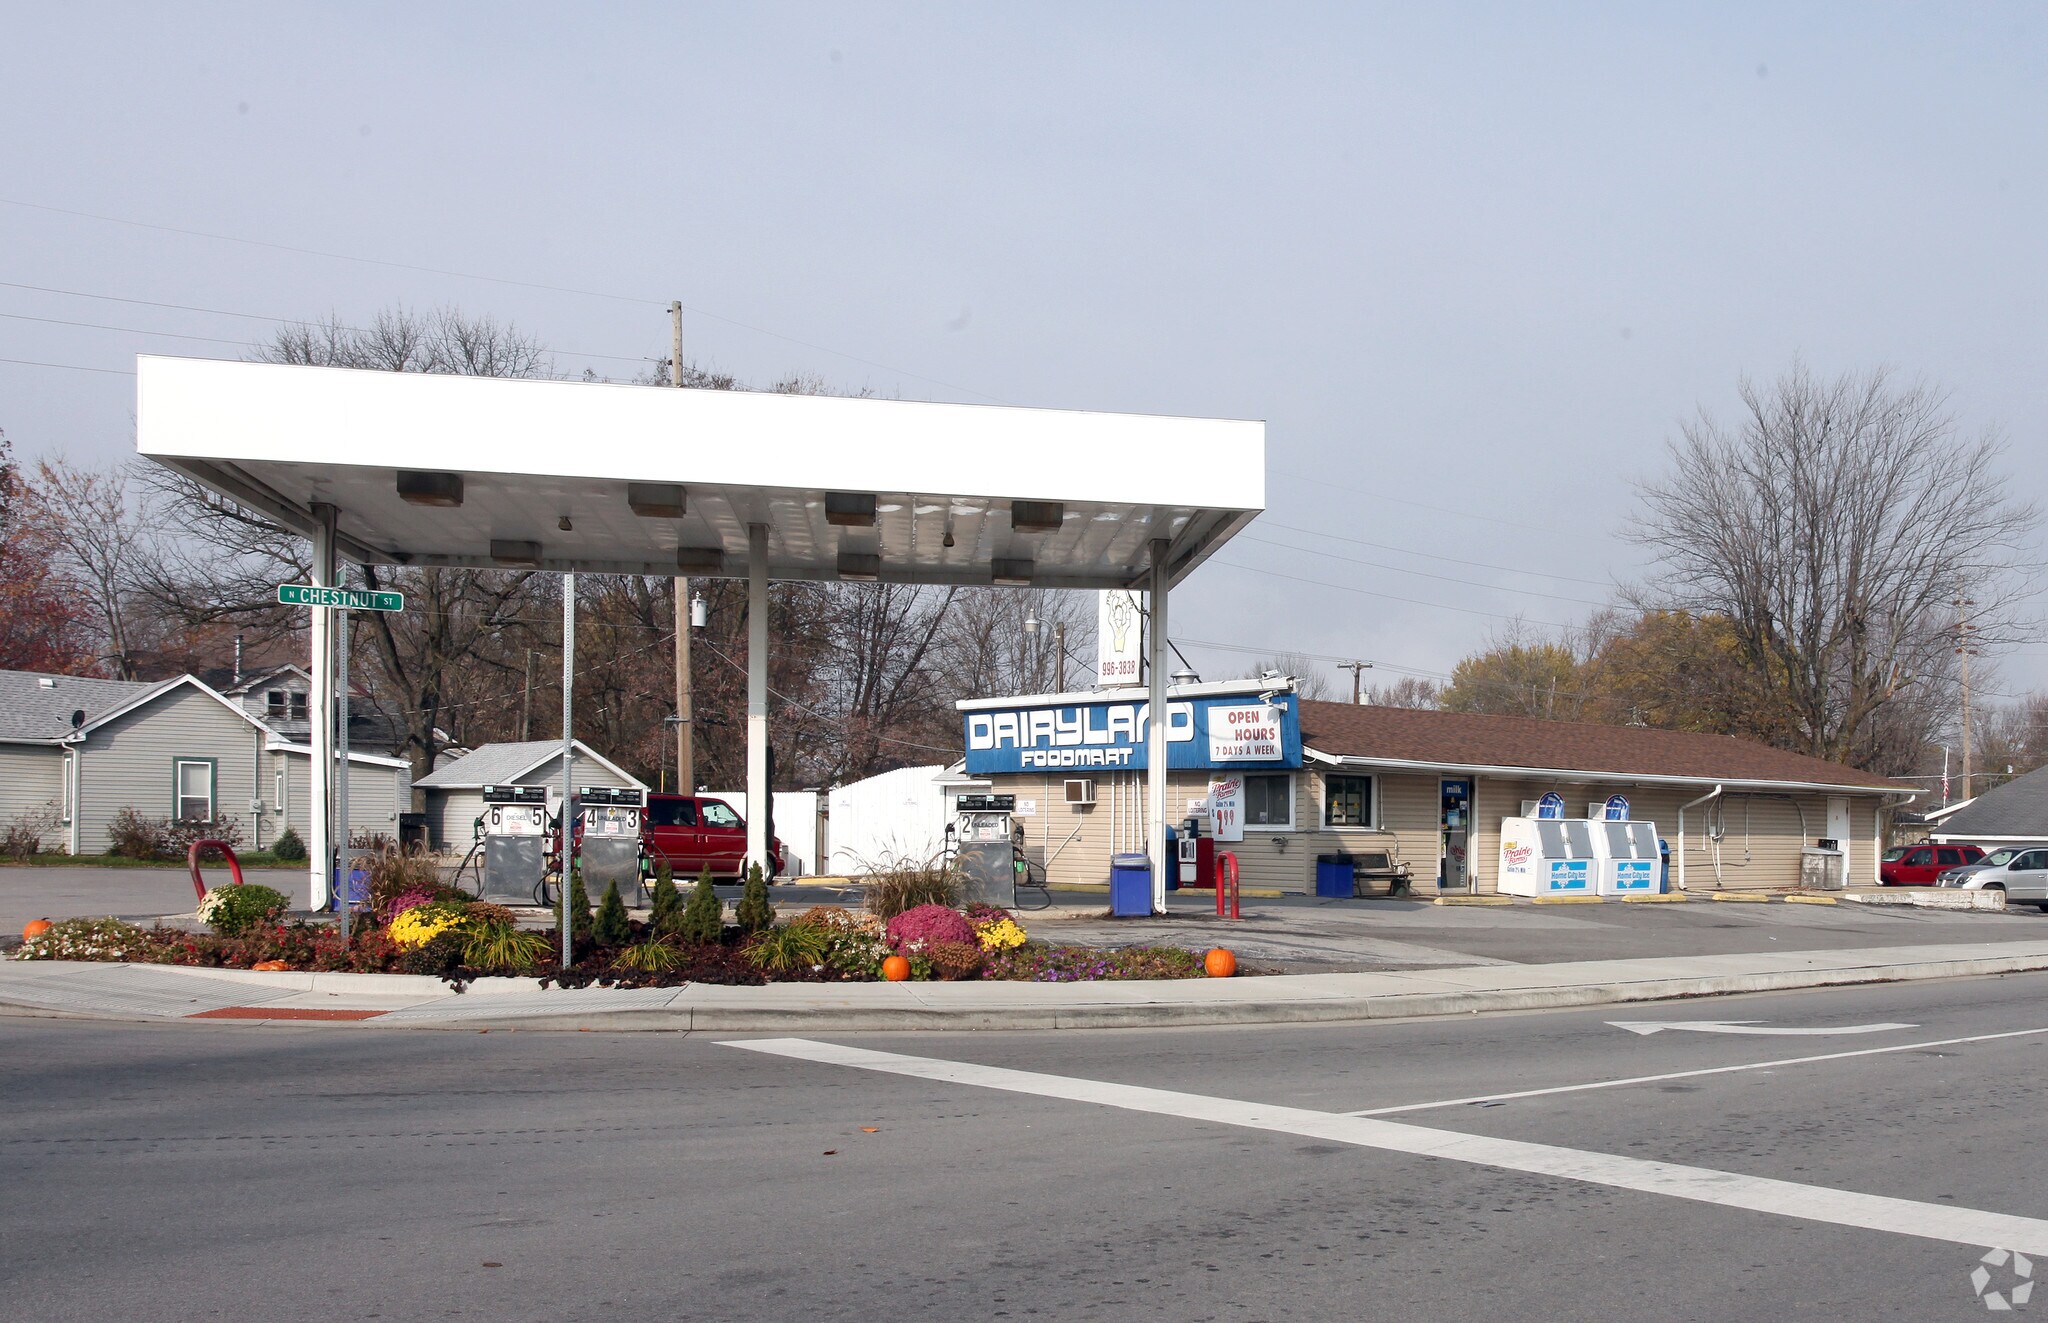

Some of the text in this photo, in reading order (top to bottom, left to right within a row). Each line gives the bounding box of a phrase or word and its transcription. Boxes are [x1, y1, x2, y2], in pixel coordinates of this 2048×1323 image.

[300, 588, 378, 607] CHESTNUT
[384, 597, 393, 606] ST
[1103, 660, 1136, 676] 996-3838
[1228, 710, 1260, 724] OPEN
[969, 701, 1195, 750] DAIRYLAND
[1235, 727, 1275, 741] HOURS
[1021, 747, 1133, 768] FOODMART
[1215, 745, 1275, 756] 7 DAYS A WEEK
[1211, 778, 1241, 794] Prairie
[1446, 785, 1462, 794] milk
[1215, 788, 1235, 799] Farms
[491, 806, 501, 826] 6
[532, 807, 542, 826] 5
[587, 809, 597, 827] 4
[627, 809, 637, 828] 3
[962, 815, 971, 834] 2
[1000, 815, 1008, 834] 1
[1503, 846, 1532, 859] Prairie
[1508, 856, 1526, 864] Farms
[1551, 871, 1586, 881] Home City Ice
[1617, 872, 1632, 880] Home
[1632, 872, 1643, 881] City
